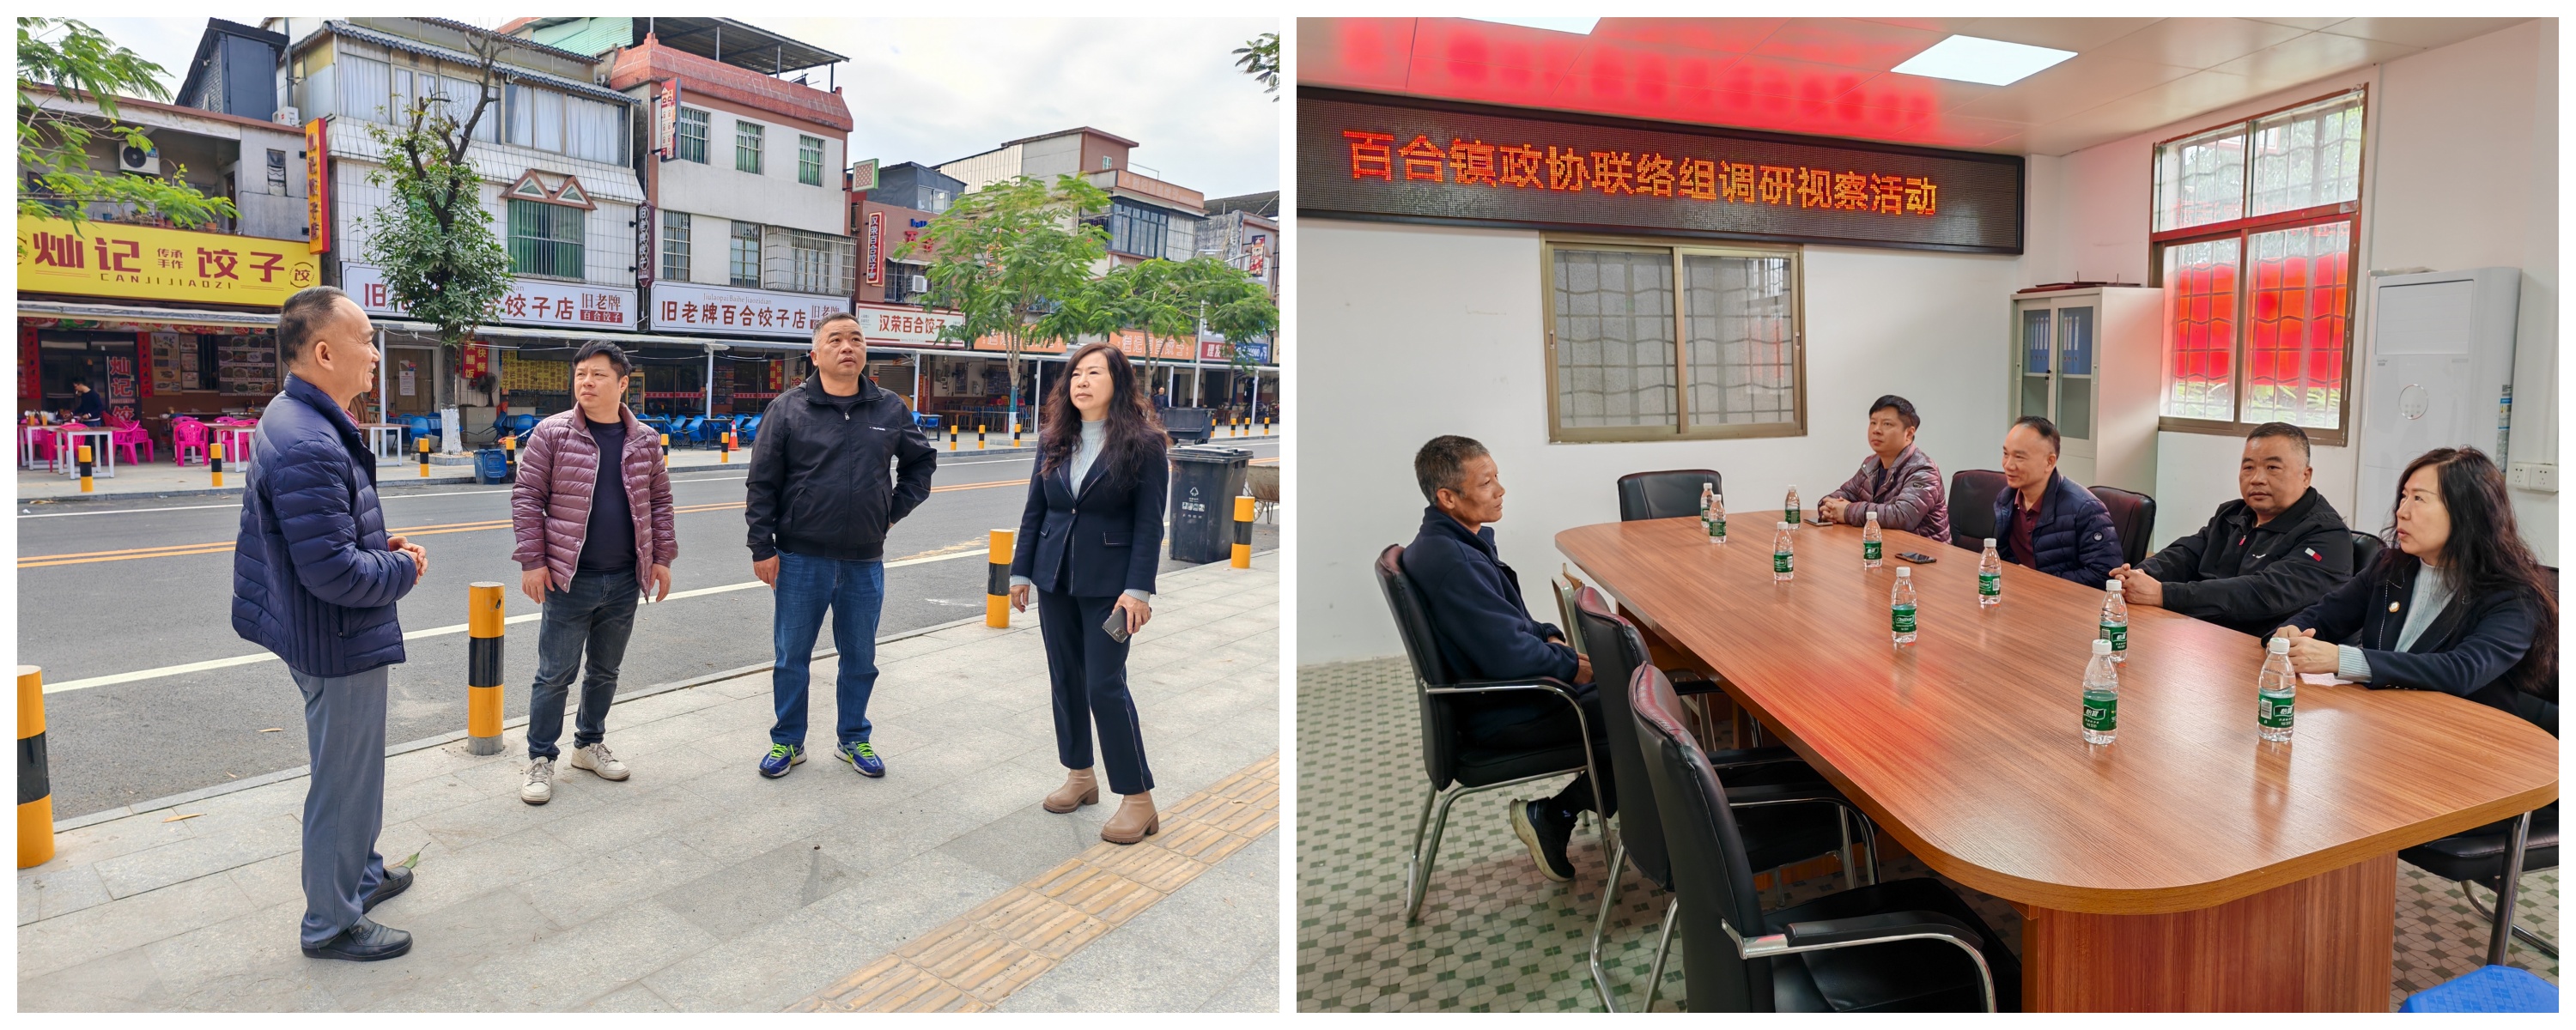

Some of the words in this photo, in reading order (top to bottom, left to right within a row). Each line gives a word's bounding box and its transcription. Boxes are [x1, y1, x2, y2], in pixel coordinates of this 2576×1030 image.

[1343, 130, 1937, 215] 百合镇政协联络组调研视察活动
[33, 231, 141, 273] 灿记
[197, 246, 285, 282] 饺子
[157, 247, 183, 259] 传承
[157, 258, 184, 270] 手作
[294, 269, 311, 282] 饺
[581, 293, 621, 312] 旧老牌
[730, 294, 744, 304] Baihe
[583, 311, 621, 323] 百合饺子
[661, 300, 806, 330] 旧老牌百合饺子店
